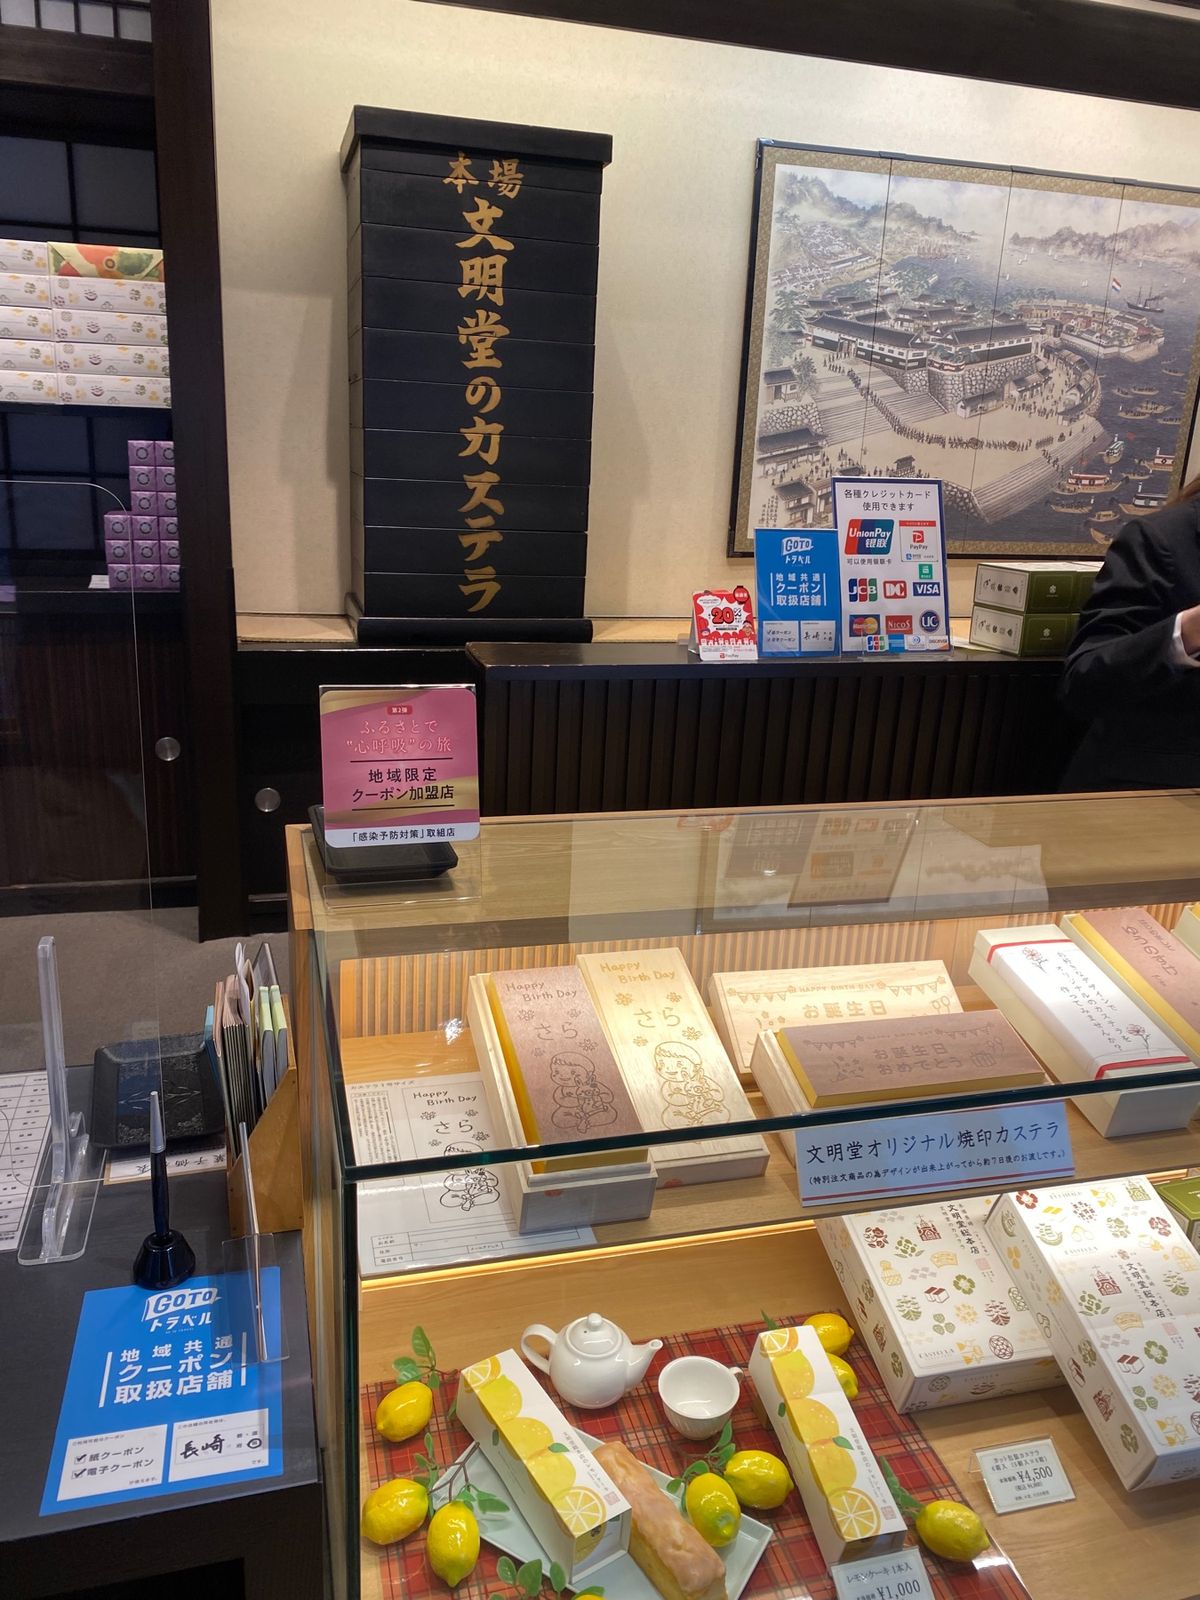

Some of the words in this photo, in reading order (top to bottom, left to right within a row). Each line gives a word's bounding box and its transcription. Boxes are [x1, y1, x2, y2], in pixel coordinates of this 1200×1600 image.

[442, 152, 524, 199] 本場
[455, 197, 515, 613] 文明堂のカステラ
[844, 489, 931, 499] 各種クレジットカード
[862, 502, 915, 512] 使用できます
[849, 527, 892, 539] UnionPay
[785, 555, 811, 564] トラベル
[775, 573, 821, 582] 地域共通
[776, 583, 821, 593] クーポン
[916, 584, 940, 594] VISA
[776, 595, 822, 606] 取扱店舗
[921, 615, 938, 627] UC
[360, 720, 439, 734] ふるさとで
[368, 767, 437, 783] 地域限定
[352, 785, 455, 803] クーポン加盟店
[352, 828, 455, 843] 「感染予防対策」取組店
[600, 962, 640, 973] Happy
[619, 974, 650, 984] Birth
[654, 970, 676, 980] Day
[505, 982, 545, 992] Happy
[522, 991, 553, 1001] Birth
[556, 989, 577, 999] Day
[633, 1007, 681, 1028] さら
[534, 1021, 578, 1041] さら
[413, 1090, 449, 1099] Happy
[427, 1097, 455, 1106] Birth
[458, 1095, 478, 1103] Day
[433, 1119, 473, 1135] さら
[807, 1121, 1059, 1164] 文明堂オリジナル焼印カステラ
[150, 1312, 212, 1332] トラベル
[120, 1334, 233, 1363] 地域共通
[118, 1352, 232, 1383] クーポン
[114, 1369, 233, 1405] 取扱店舗
[180, 1433, 225, 1459] 長崎
[88, 1447, 145, 1462] 紙クーポン
[87, 1459, 154, 1476] 電子クーポン
[1017, 1465, 1053, 1483] ¥4,500
